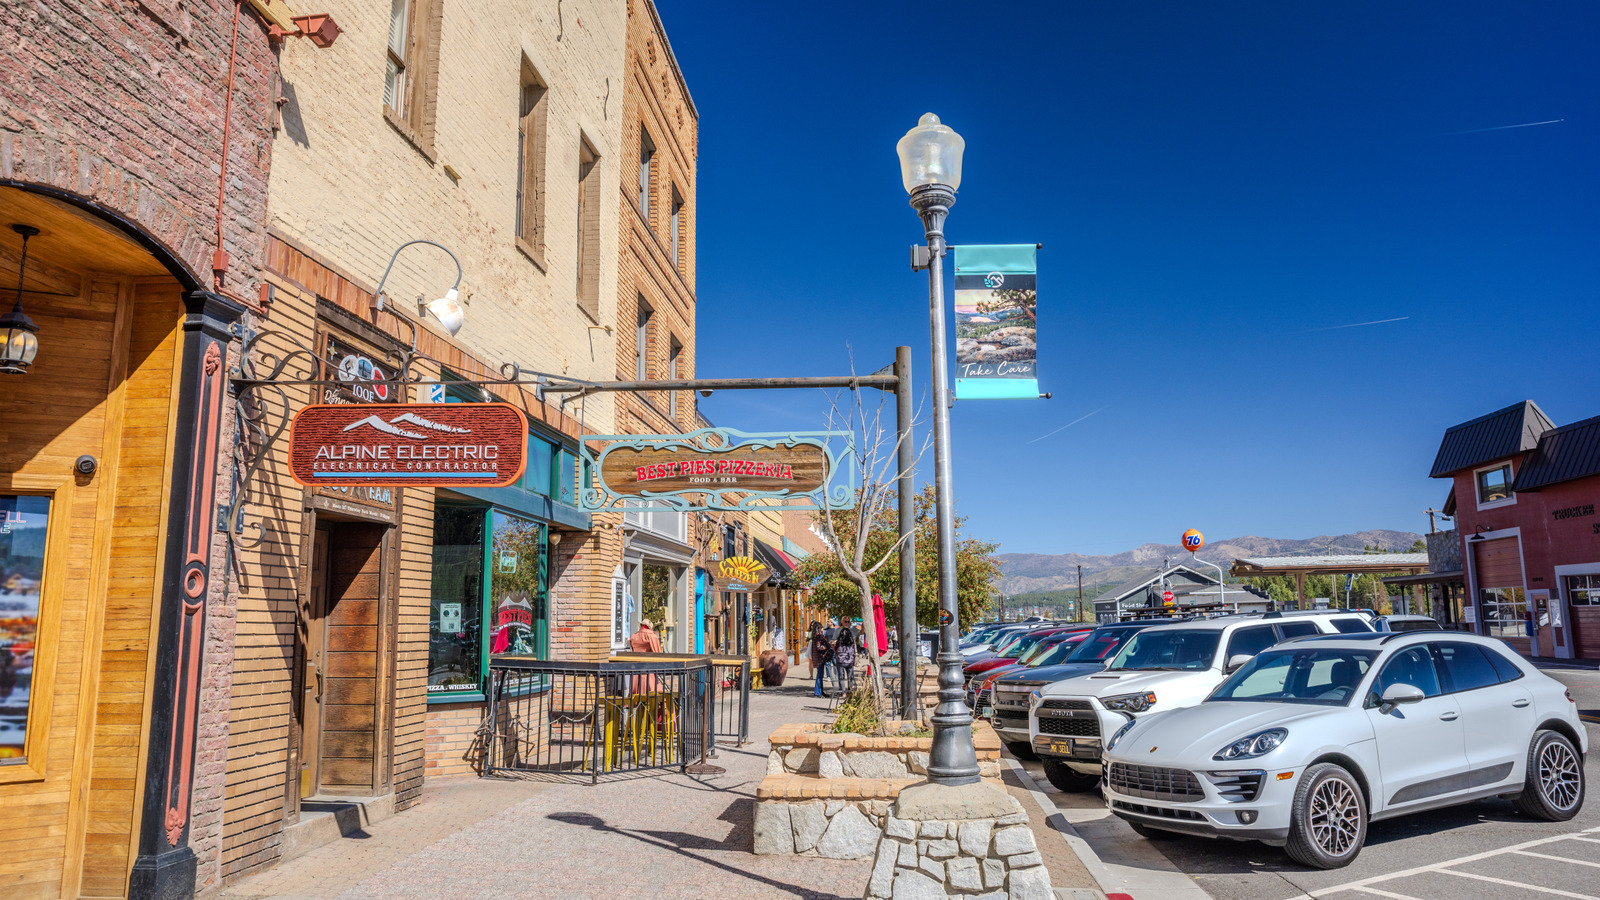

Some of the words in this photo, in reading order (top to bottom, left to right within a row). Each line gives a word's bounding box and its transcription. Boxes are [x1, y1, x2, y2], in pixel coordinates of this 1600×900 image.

[961, 362, 993, 378] Take
[996, 360, 1032, 376] Care
[315, 445, 391, 459] ALPINE
[396, 445, 498, 459] ELECTRIC
[313, 462, 396, 470] ELECTRICAL
[407, 462, 498, 470] CONTRACTOR
[636, 462, 677, 482] BEST
[680, 459, 716, 477] PIES
[719, 459, 794, 481] PIZZERIA
[1552, 504, 1595, 520] TRUCKEE
[1186, 534, 1201, 546] 76
[517, 608, 533, 626] PIES
